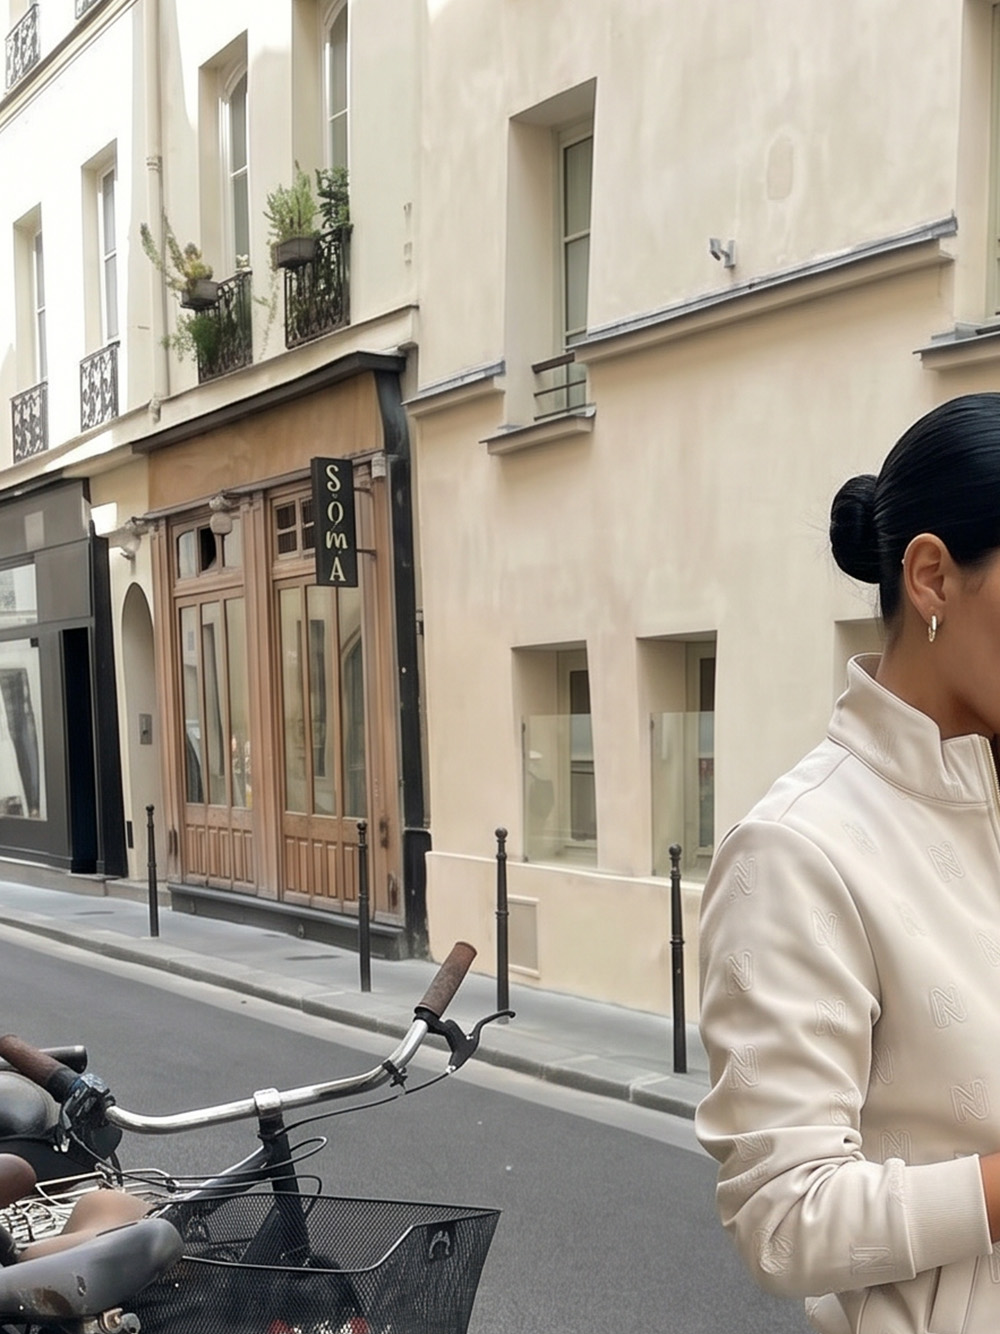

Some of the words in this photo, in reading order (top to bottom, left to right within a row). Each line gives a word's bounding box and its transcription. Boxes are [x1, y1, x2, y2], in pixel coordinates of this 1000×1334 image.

[930, 841, 965, 883] N
[929, 982, 968, 1029] N
[951, 1078, 990, 1124] N
